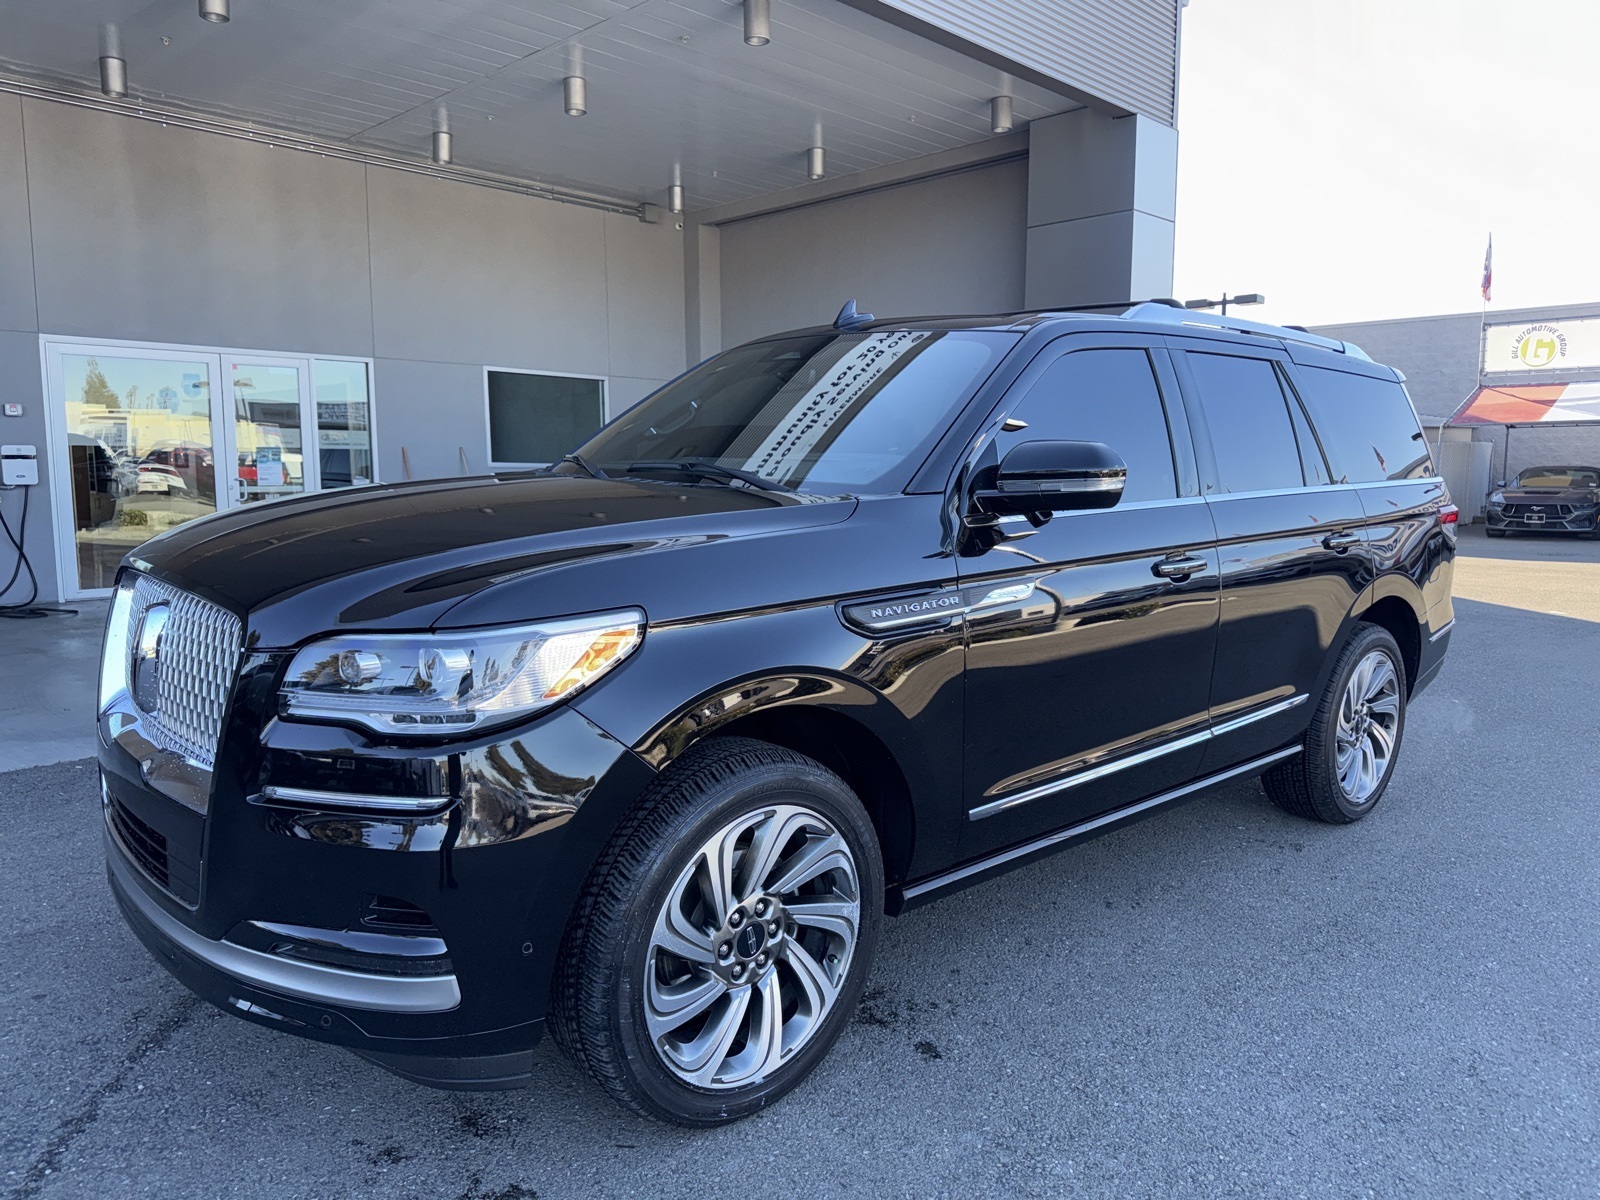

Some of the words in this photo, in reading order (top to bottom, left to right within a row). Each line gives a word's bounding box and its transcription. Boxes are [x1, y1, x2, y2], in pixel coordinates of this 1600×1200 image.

[1511, 345, 1519, 359] GILL
[1515, 325, 1559, 344] AUTOMOTIVE
[1556, 333, 1567, 357] GROUP
[871, 596, 959, 618] NAVIGATOR
